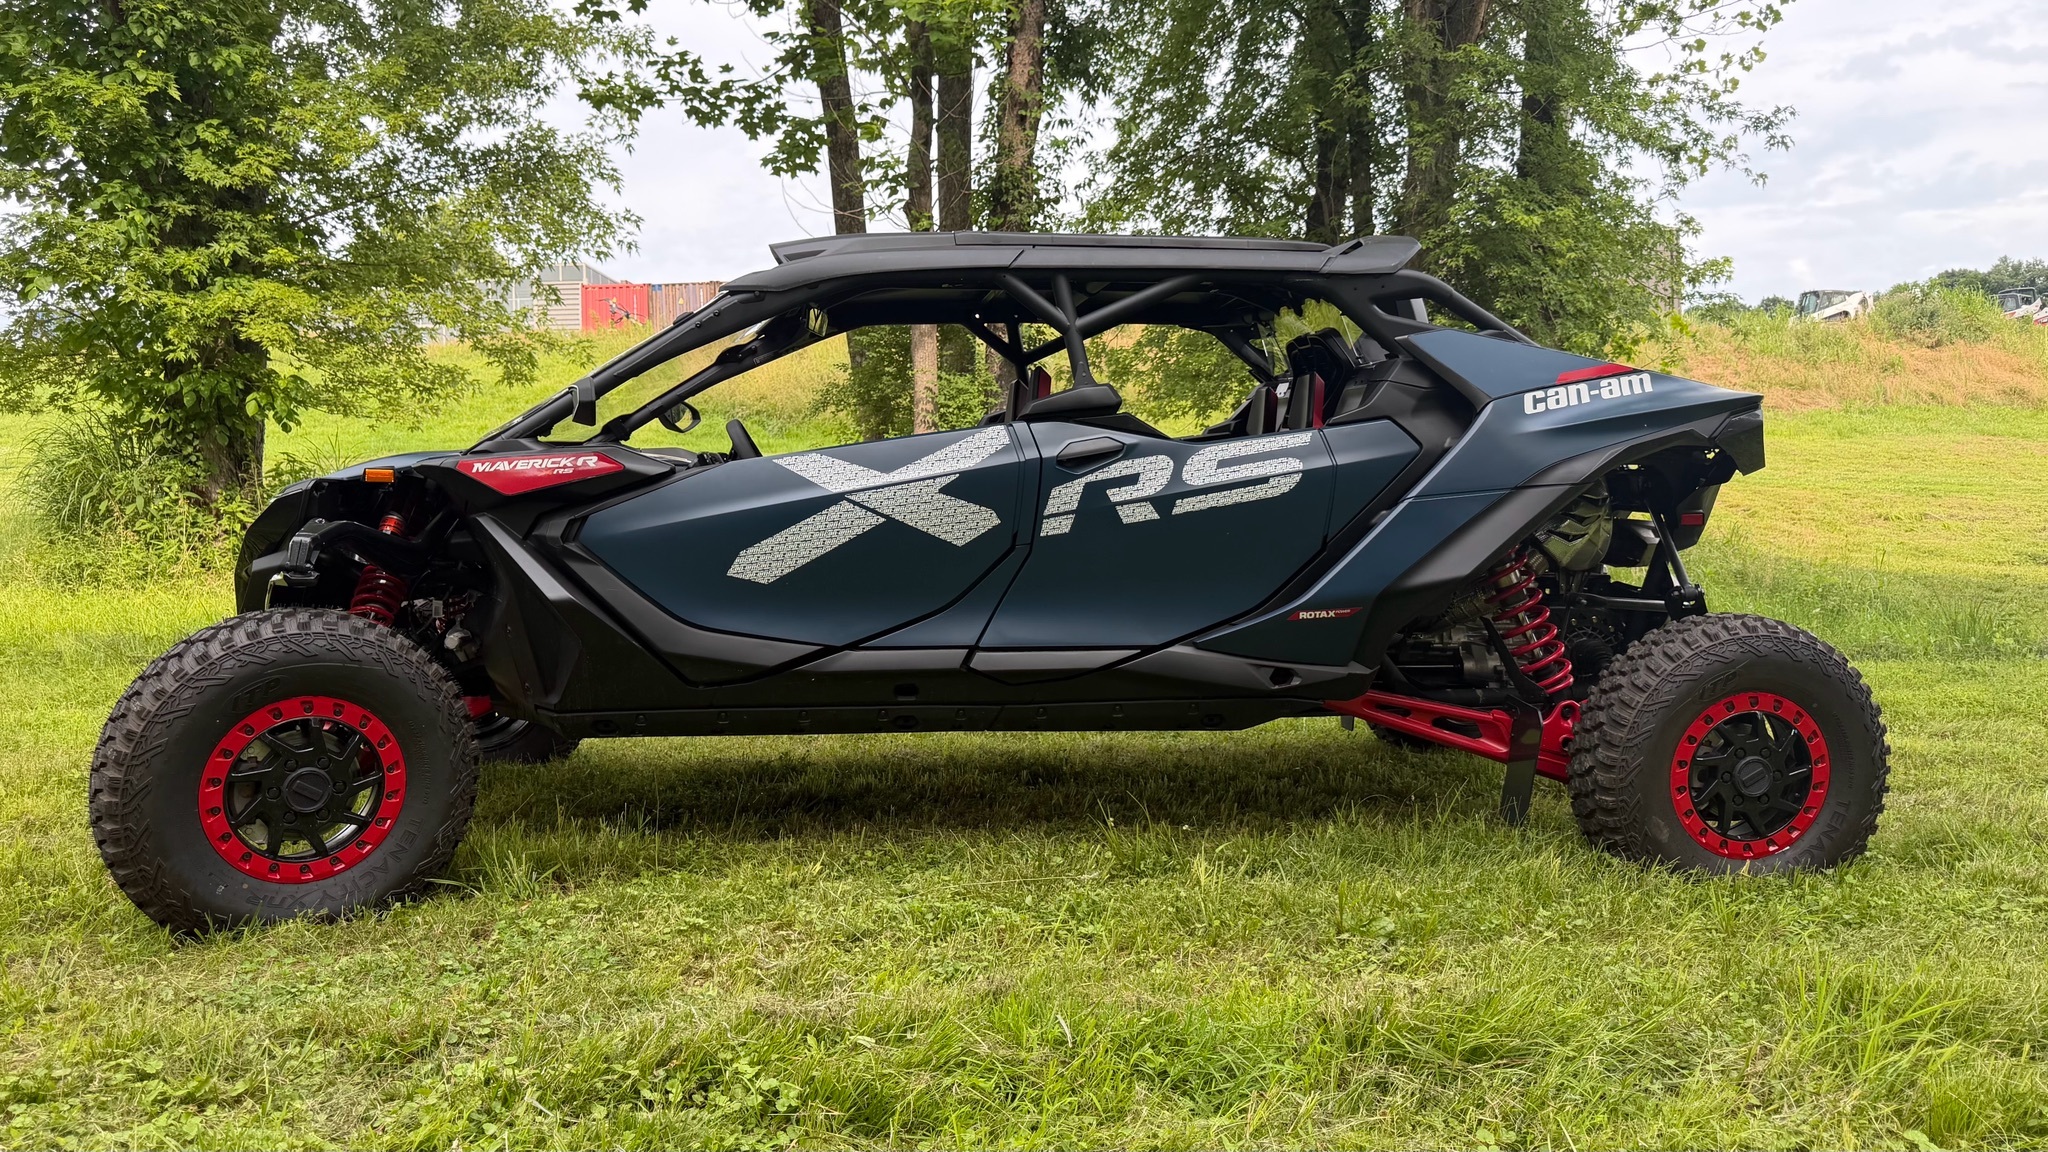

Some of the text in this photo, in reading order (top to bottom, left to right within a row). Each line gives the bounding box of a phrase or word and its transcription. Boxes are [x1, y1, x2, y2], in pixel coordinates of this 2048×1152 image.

[1524, 372, 1653, 414] can-am
[472, 457, 575, 473] MAVERICK
[1039, 431, 1312, 538] RS
[1299, 610, 1336, 619] ROTAX
